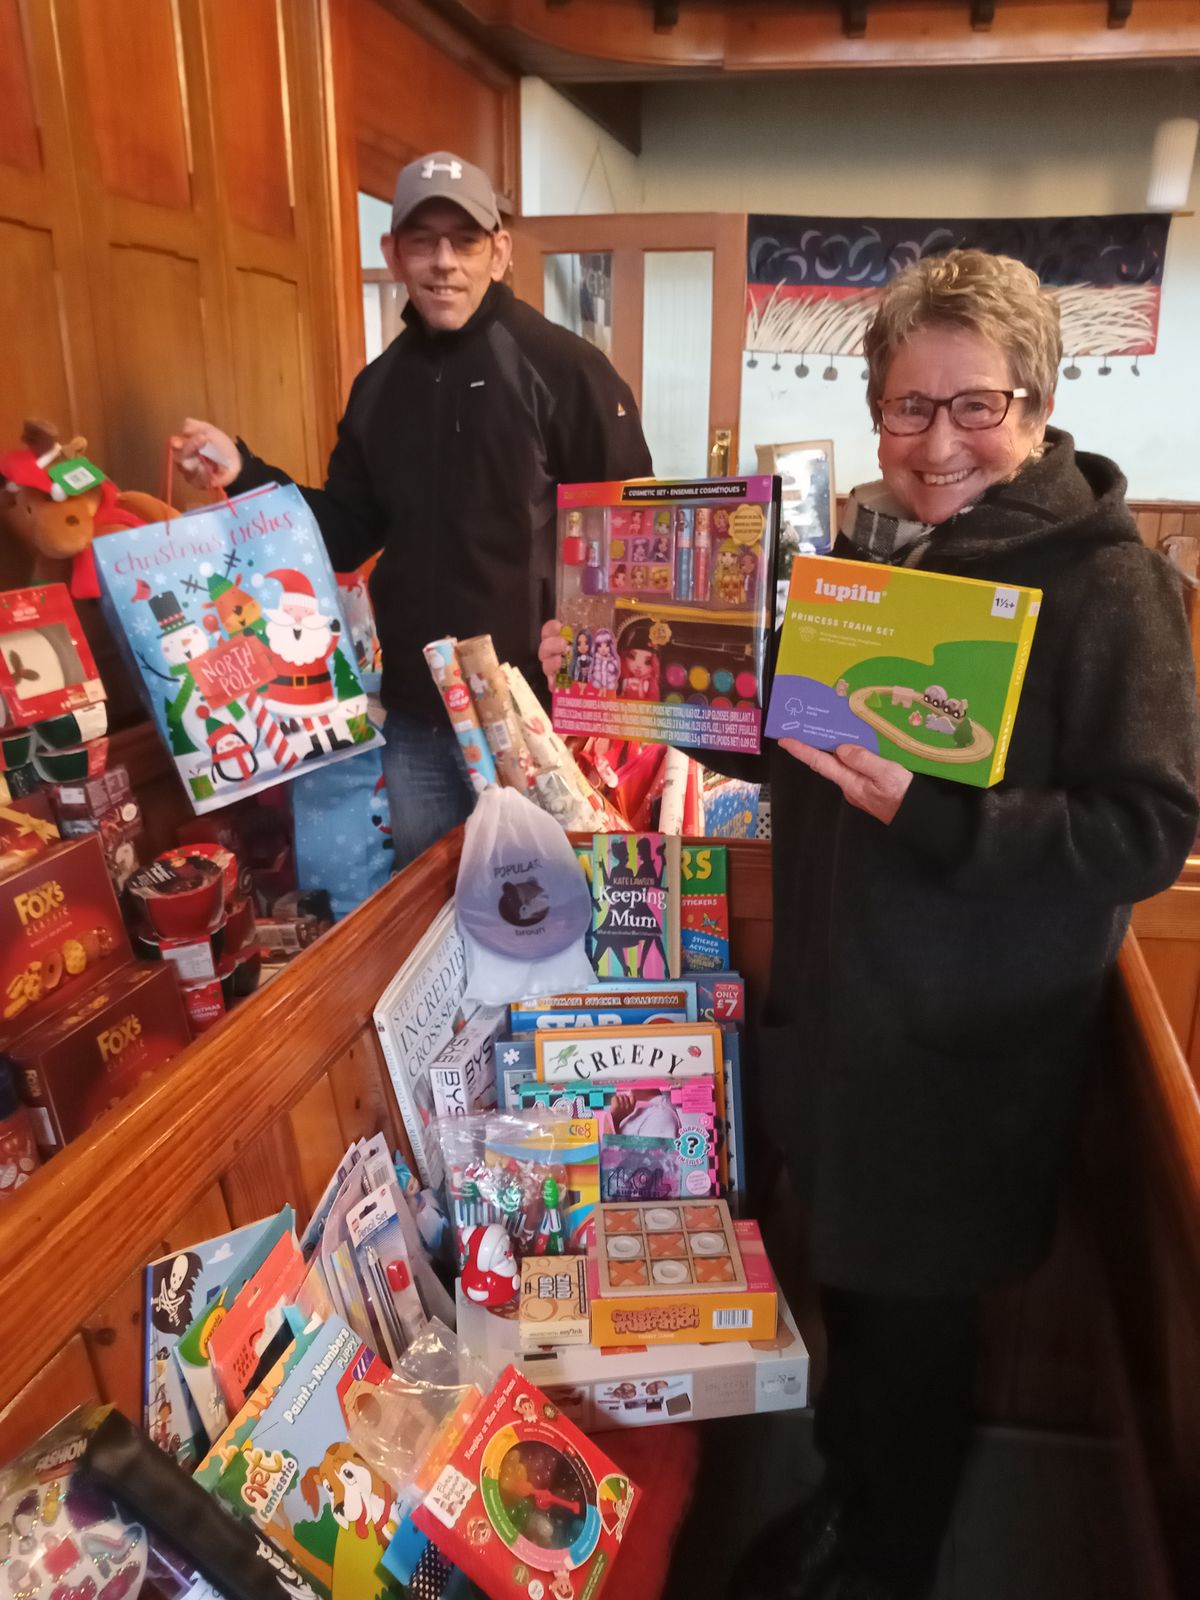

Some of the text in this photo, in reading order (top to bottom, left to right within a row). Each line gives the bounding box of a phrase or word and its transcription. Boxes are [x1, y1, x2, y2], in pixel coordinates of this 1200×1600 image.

[628, 489, 655, 497] COSMETIC
[670, 487, 699, 496] ENSEMBLE
[815, 577, 881, 604] lupilu
[791, 611, 895, 637] PRINCESS TRAIN SET
[201, 641, 256, 684] NORTH
[219, 665, 260, 698] POLE
[613, 877, 629, 886] KATE
[599, 886, 667, 910] Keeping
[609, 909, 657, 928] Mum
[692, 936, 719, 947] STICKER
[399, 940, 465, 1053] INCREDIB
[717, 998, 738, 1017] £7
[465, 1036, 493, 1086] BYS
[574, 1044, 685, 1080] CREEPY
[568, 1122, 592, 1138] cre8
[375, 1210, 388, 1224] Set
[336, 1337, 359, 1370] PUPPY
[282, 1327, 350, 1424] Paint by Numbers
